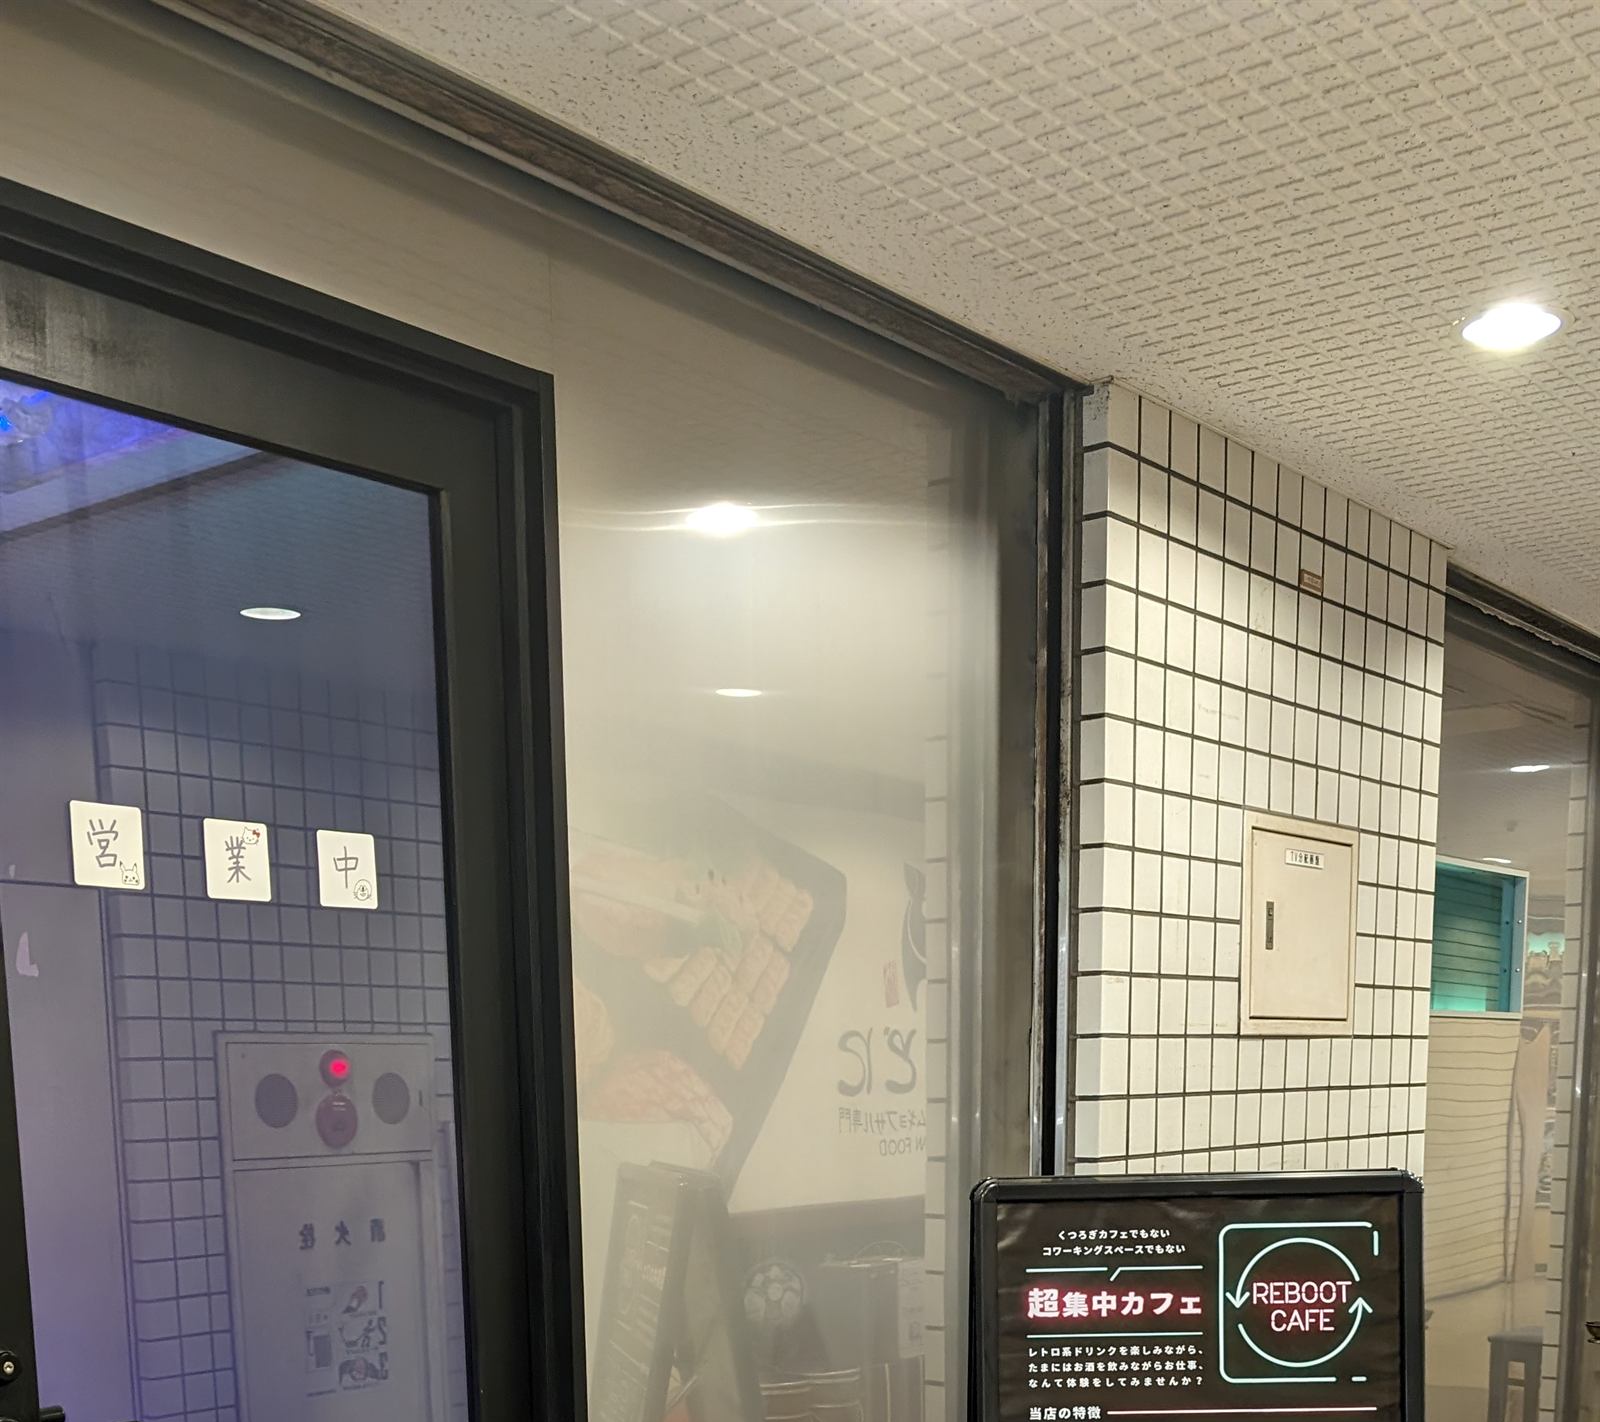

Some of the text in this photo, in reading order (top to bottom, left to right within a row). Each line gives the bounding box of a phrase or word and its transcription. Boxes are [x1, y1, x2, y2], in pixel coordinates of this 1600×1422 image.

[1058, 1229, 1170, 1240] くつろぎカフェでもない
[1042, 1244, 1186, 1256] コワーキングスペースでもない
[1252, 1281, 1352, 1304] REBOOT
[1027, 1287, 1202, 1319] 超集中カフェ
[1270, 1309, 1335, 1332] CAFE
[1028, 1345, 1203, 1357] レトロ系ドリンクを楽しみながら、
[1028, 1360, 1203, 1372] たまにはお酒を飲みながらお仕事、
[1028, 1377, 1203, 1388] なんて体験をしてみませんか？
[1029, 1406, 1101, 1421] 当店の特徴
